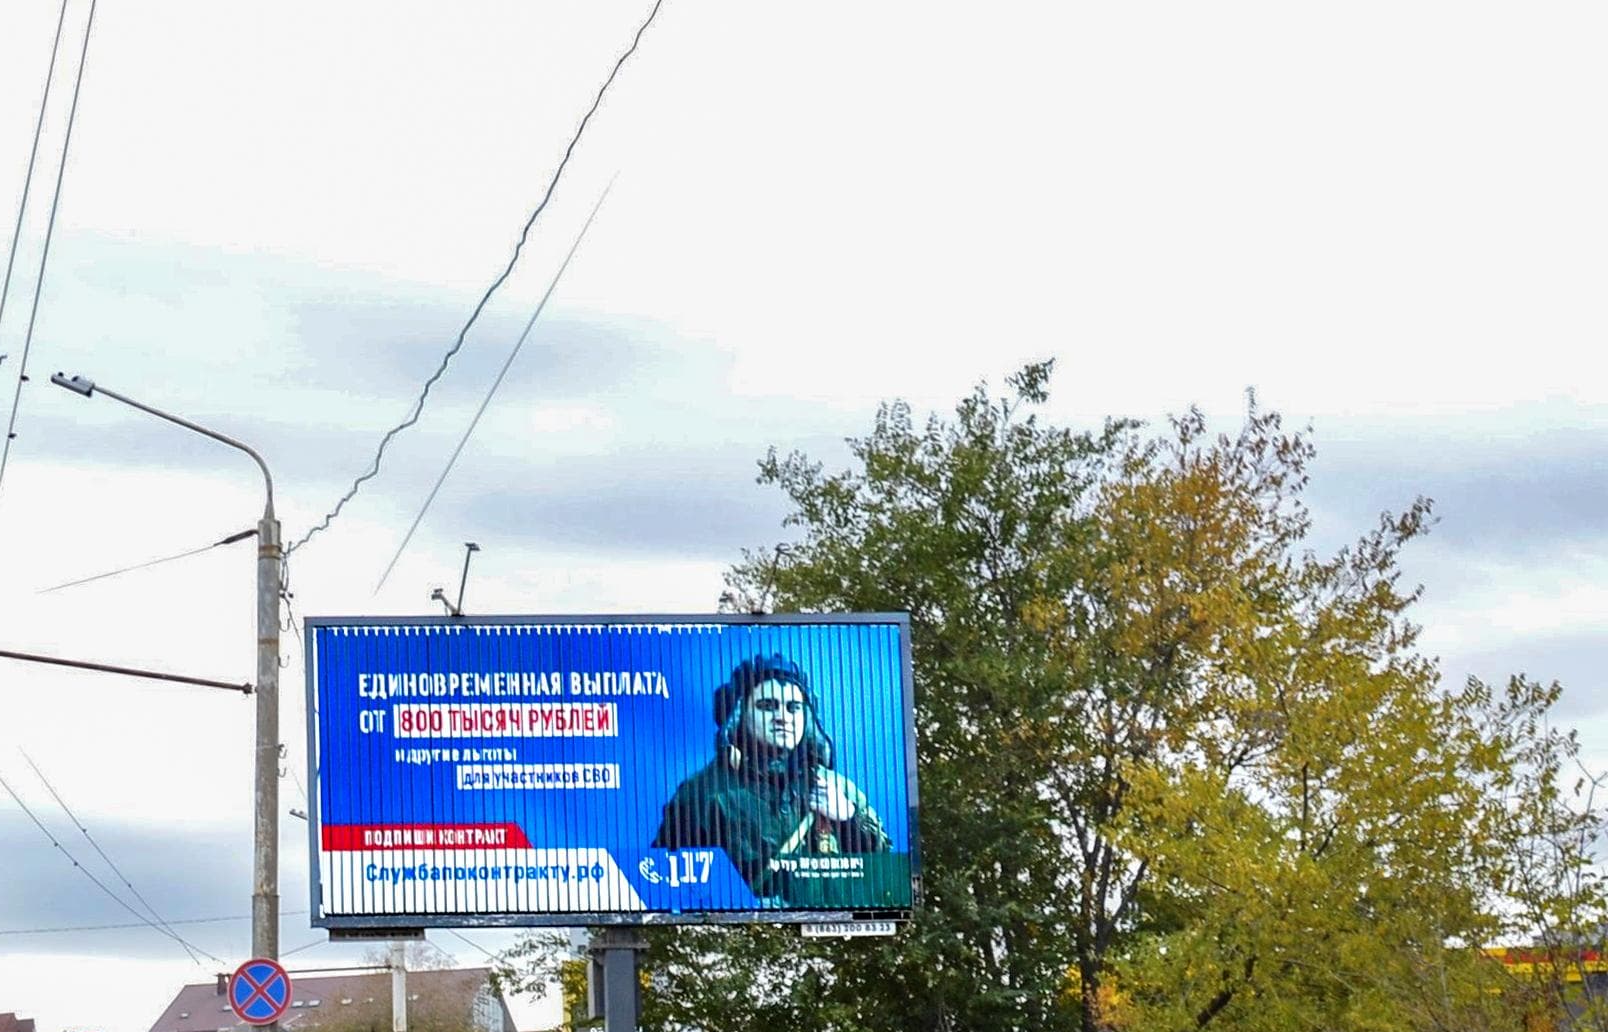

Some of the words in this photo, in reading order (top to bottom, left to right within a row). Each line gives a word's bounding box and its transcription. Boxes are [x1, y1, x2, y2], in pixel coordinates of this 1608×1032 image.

[359, 672, 561, 699] ЕДИНОВРЕМЕННАЯ
[570, 672, 669, 698] ВЫПЛАТА
[359, 710, 386, 733] ОТ
[400, 709, 442, 732] 800
[448, 709, 521, 732] ТЫСЯЧ
[529, 704, 610, 731] РУБЛЕЙ
[494, 770, 580, 788] участников
[583, 768, 611, 783] СВО
[365, 831, 436, 847] ПОДПИШИ
[439, 829, 507, 846] КОНТРАКТ
[366, 863, 605, 886] Службапоконтракту.рф
[666, 852, 714, 887] 117
